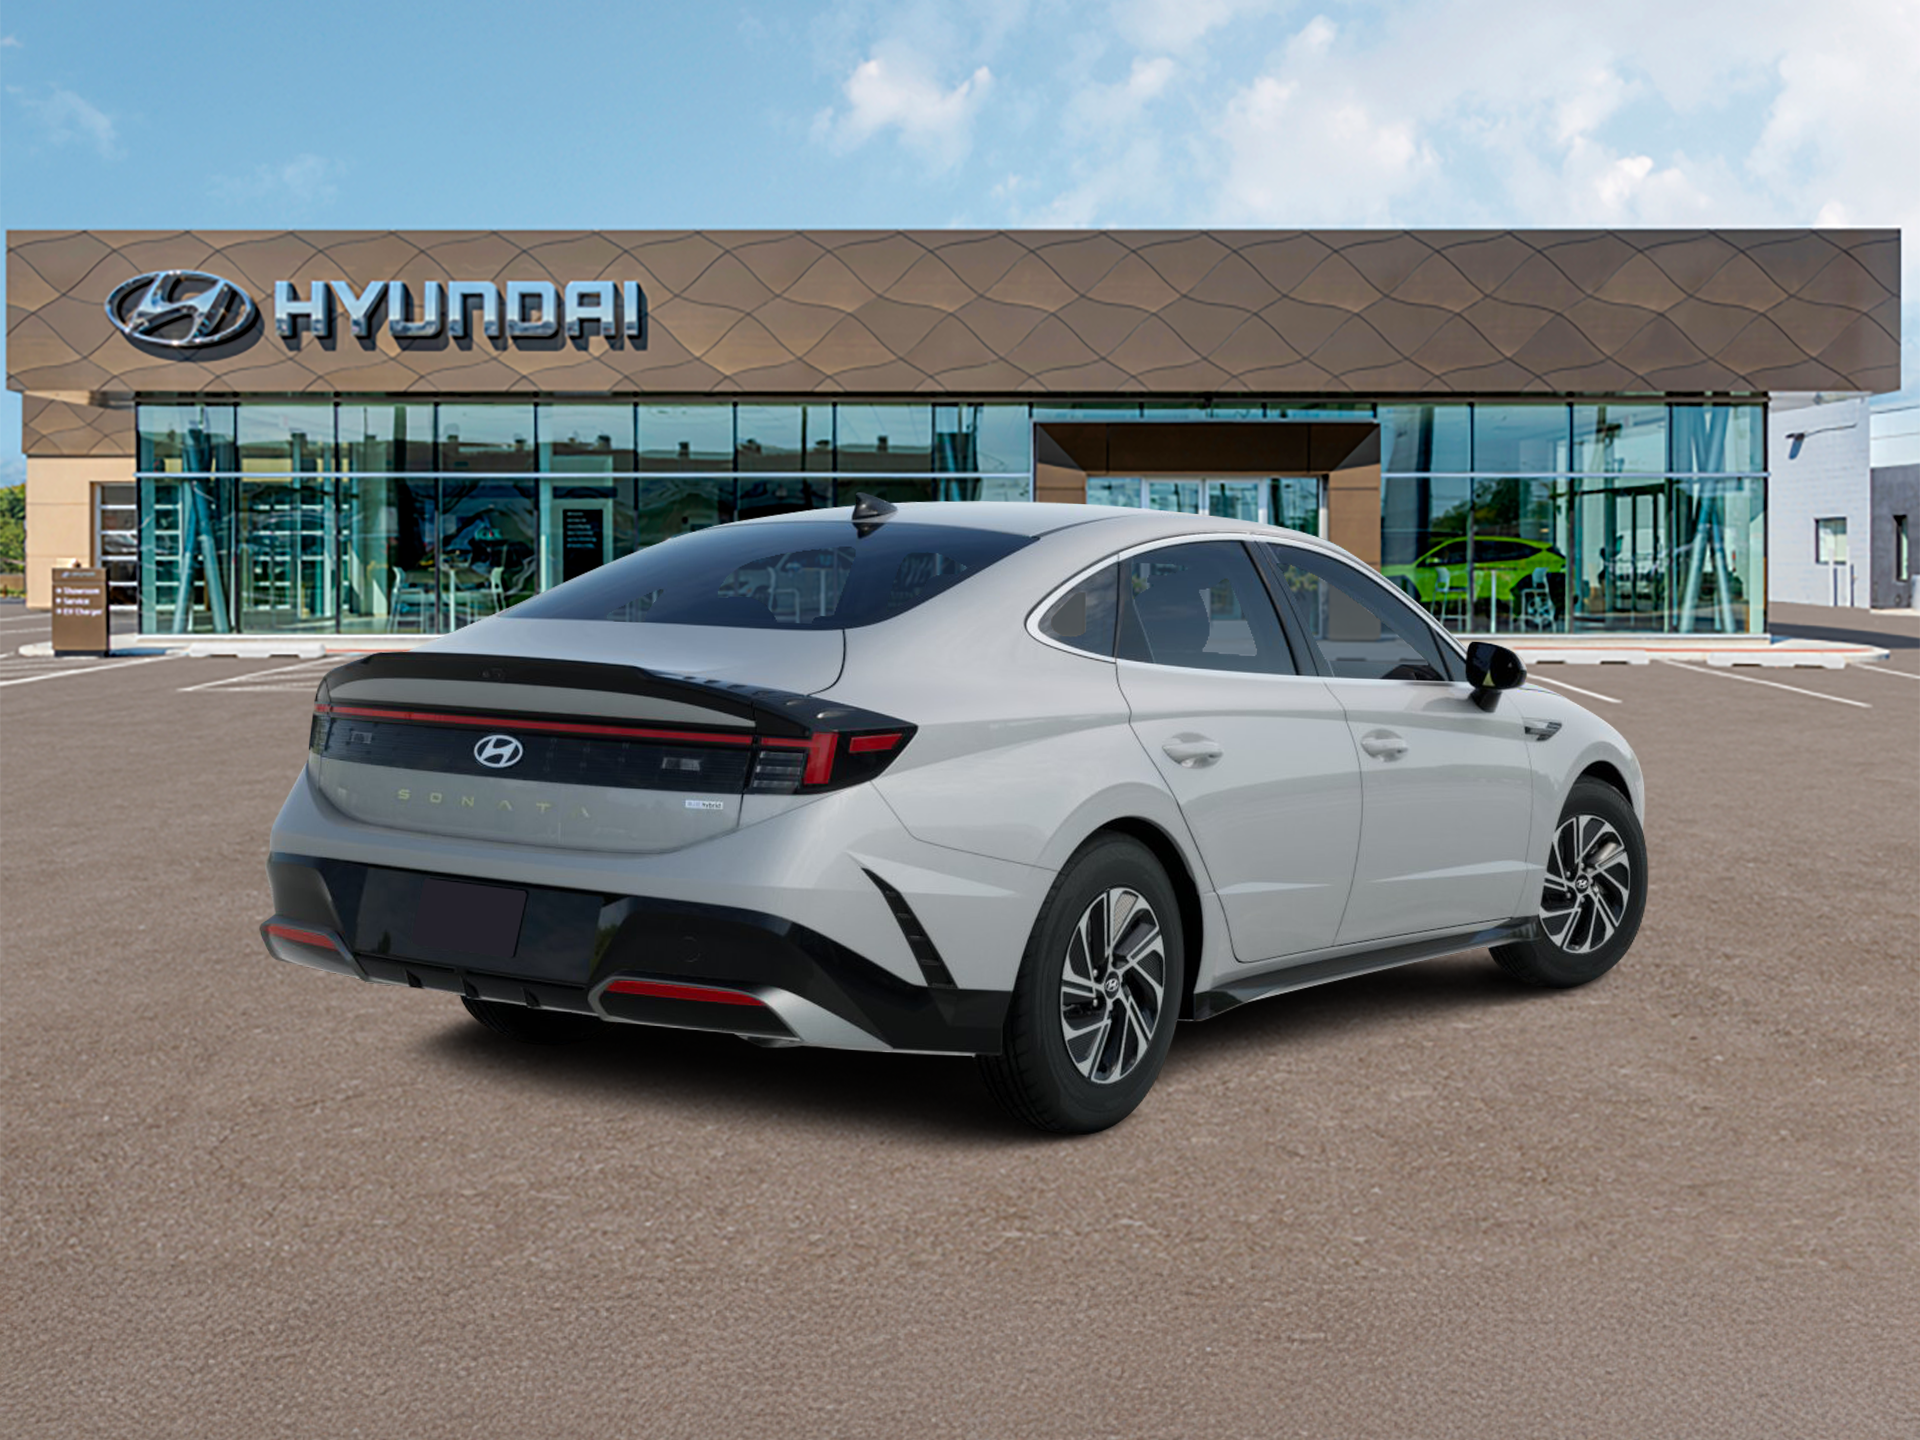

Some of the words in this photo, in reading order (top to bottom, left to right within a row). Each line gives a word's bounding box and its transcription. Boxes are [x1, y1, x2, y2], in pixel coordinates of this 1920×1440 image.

[274, 280, 641, 340] HYUNDAI
[63, 587, 100, 595] Showroom
[397, 788, 590, 819] SONATA
